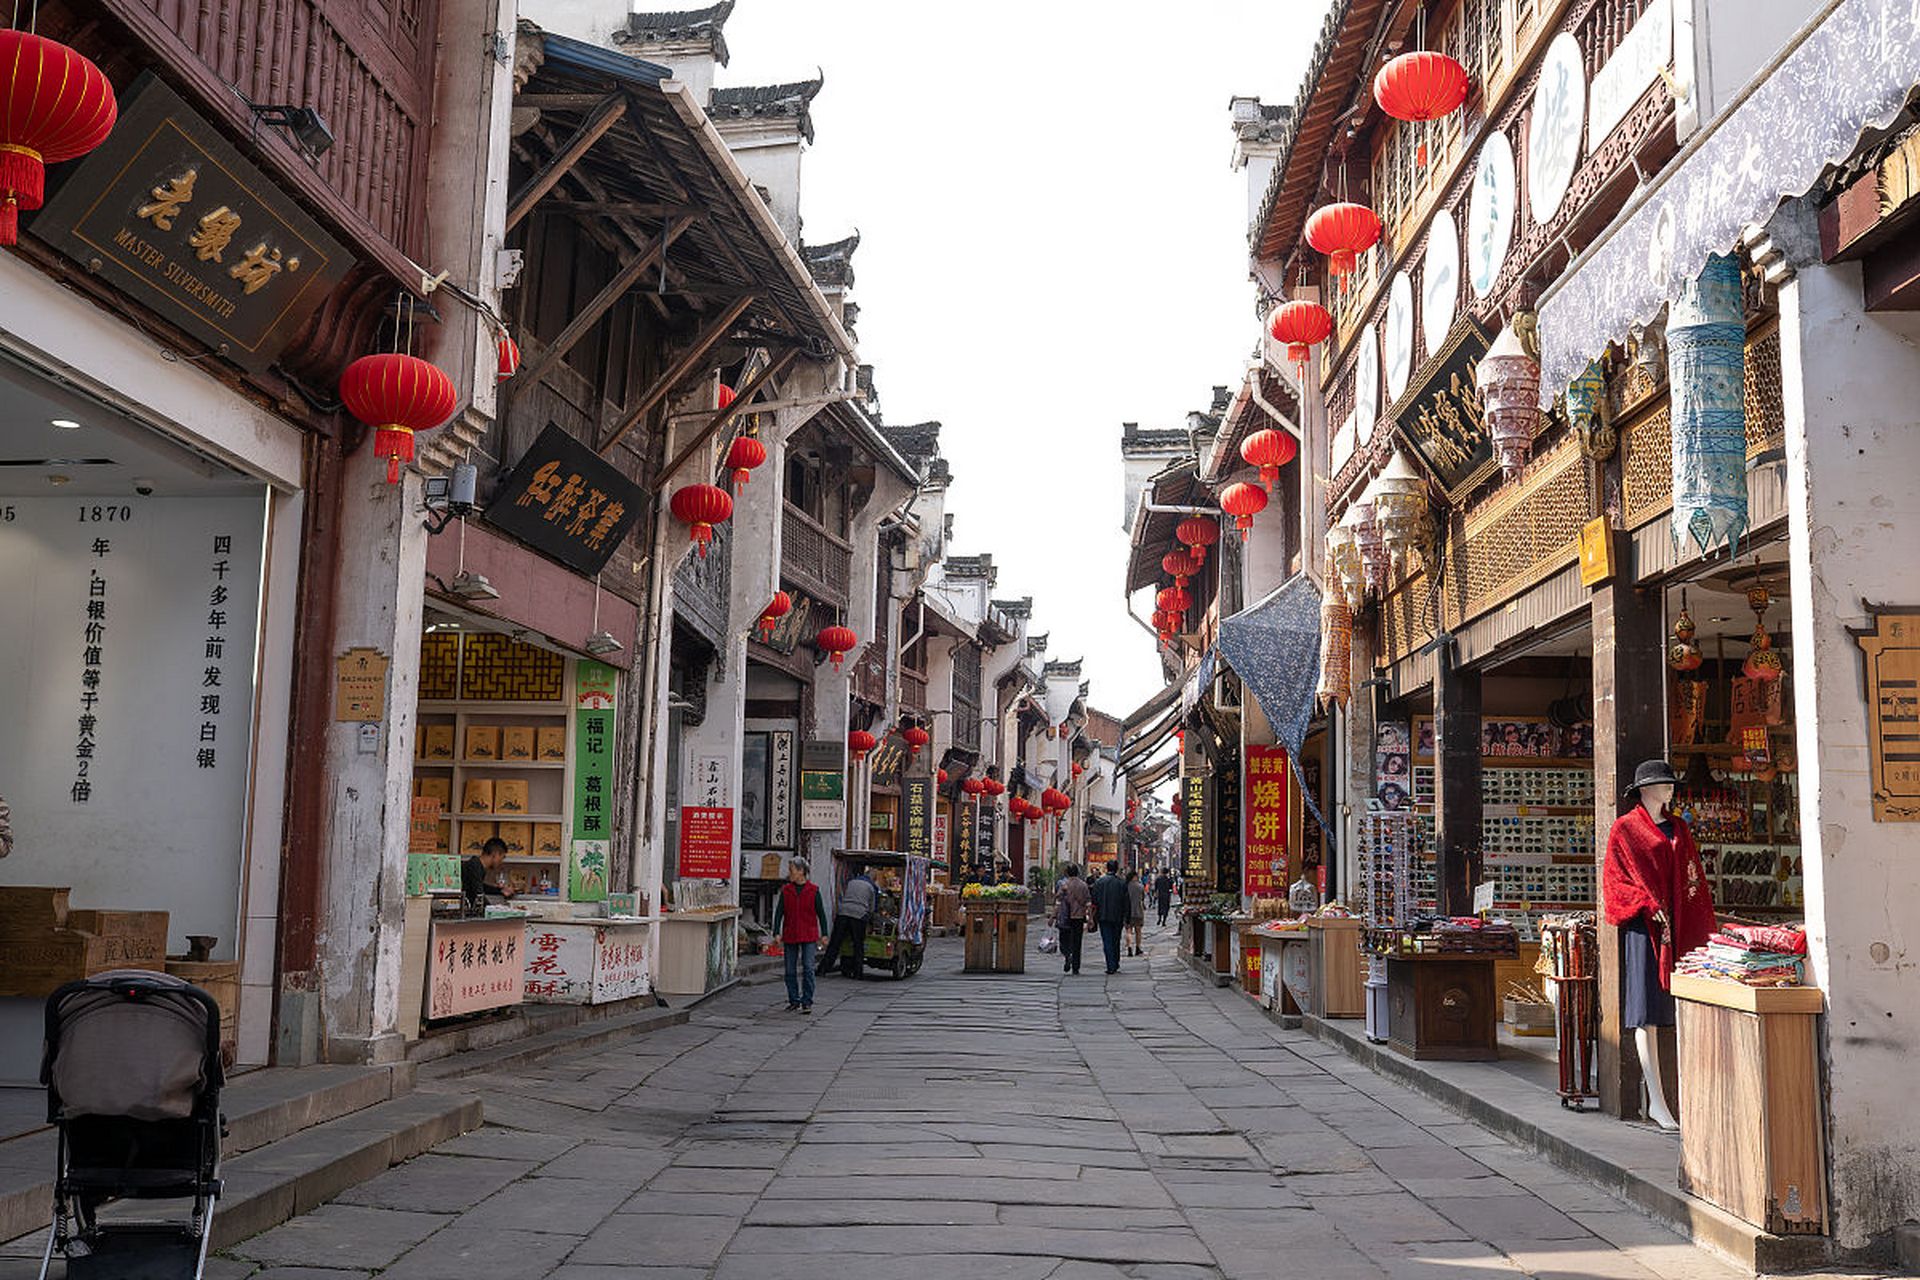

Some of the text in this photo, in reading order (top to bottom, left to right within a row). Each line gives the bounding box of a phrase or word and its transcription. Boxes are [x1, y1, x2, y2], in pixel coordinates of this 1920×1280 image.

[113, 228, 237, 319] MASTER SILVERSMITH
[79, 506, 131, 522] 1870
[196, 535, 231, 769] 四千多年前发现白银
[1250, 757, 1284, 774] 蟹壳黄
[1252, 780, 1281, 840] 烧饼
